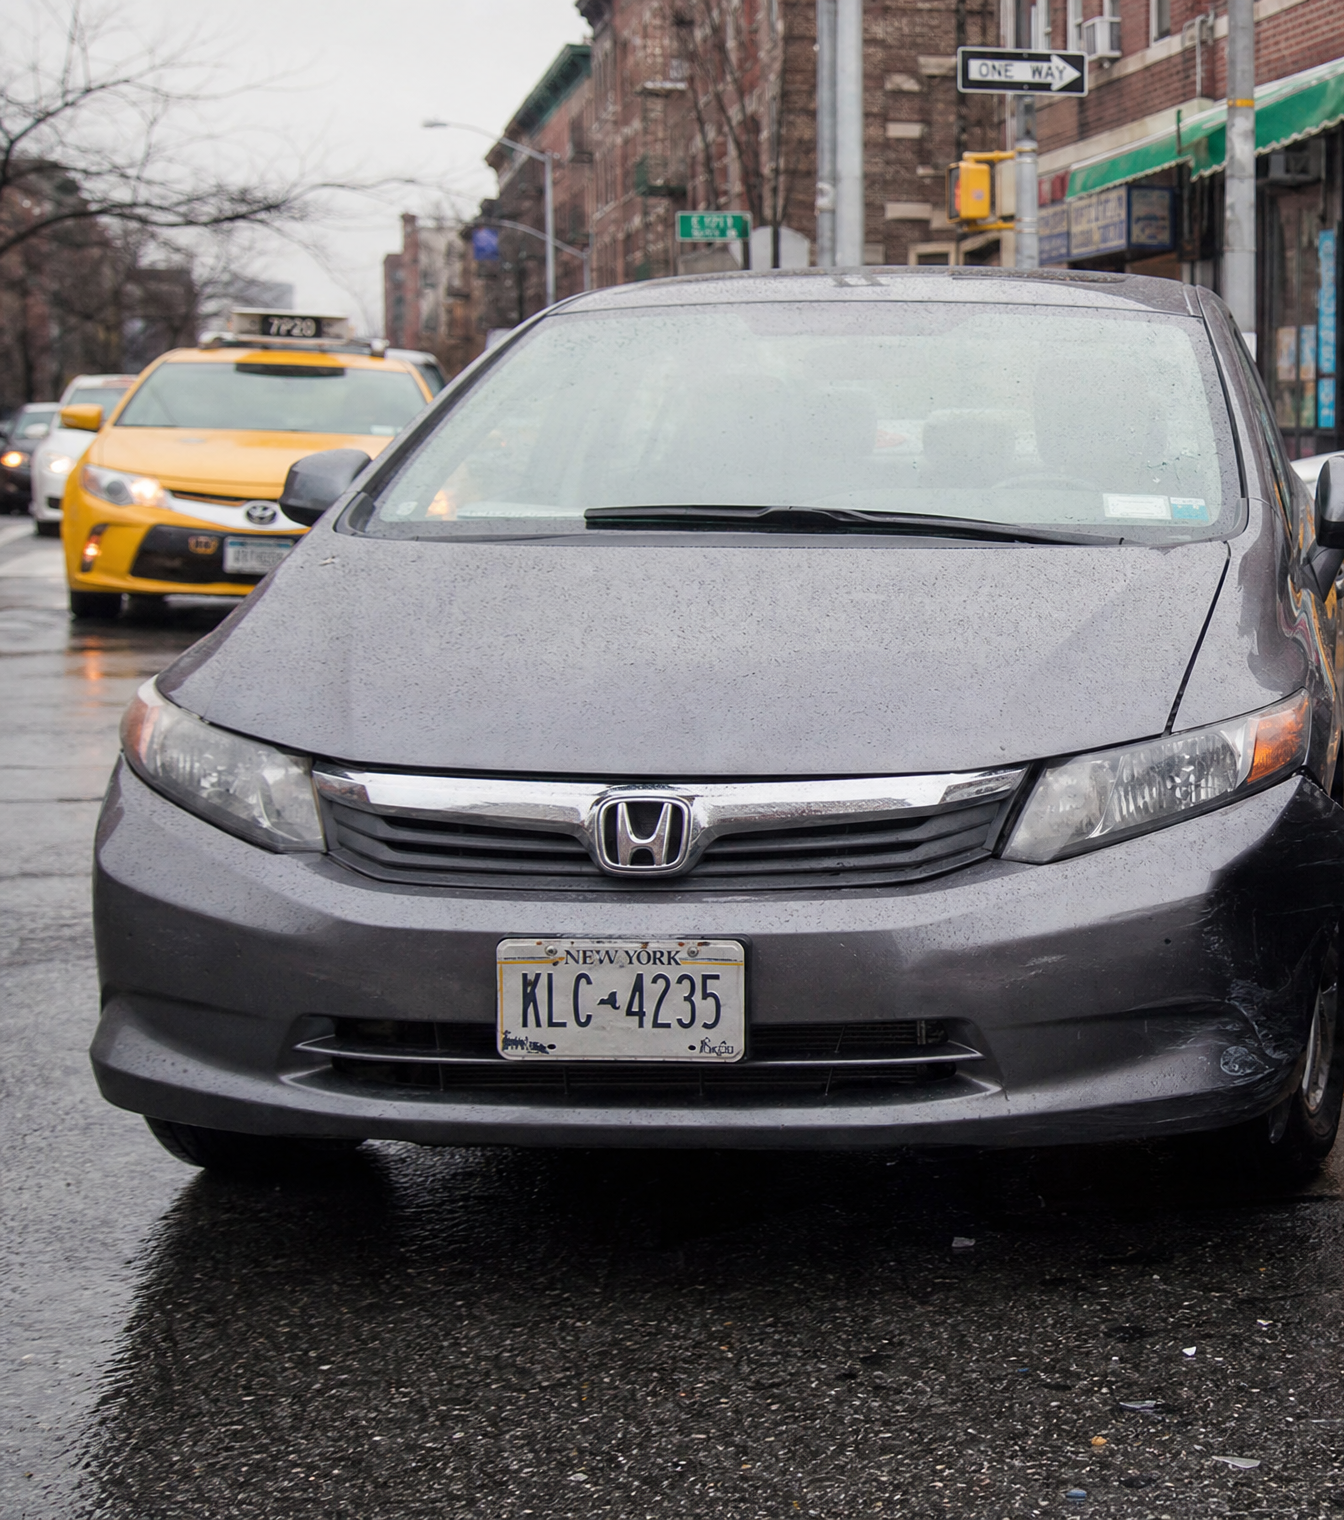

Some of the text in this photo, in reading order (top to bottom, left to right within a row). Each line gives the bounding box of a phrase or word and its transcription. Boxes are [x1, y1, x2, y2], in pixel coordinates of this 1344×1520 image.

[978, 62, 1067, 81] ONE WAY
[267, 316, 317, 337] 7P20
[563, 949, 682, 966] NEW YORK
[521, 971, 722, 1030] KLC 4235
